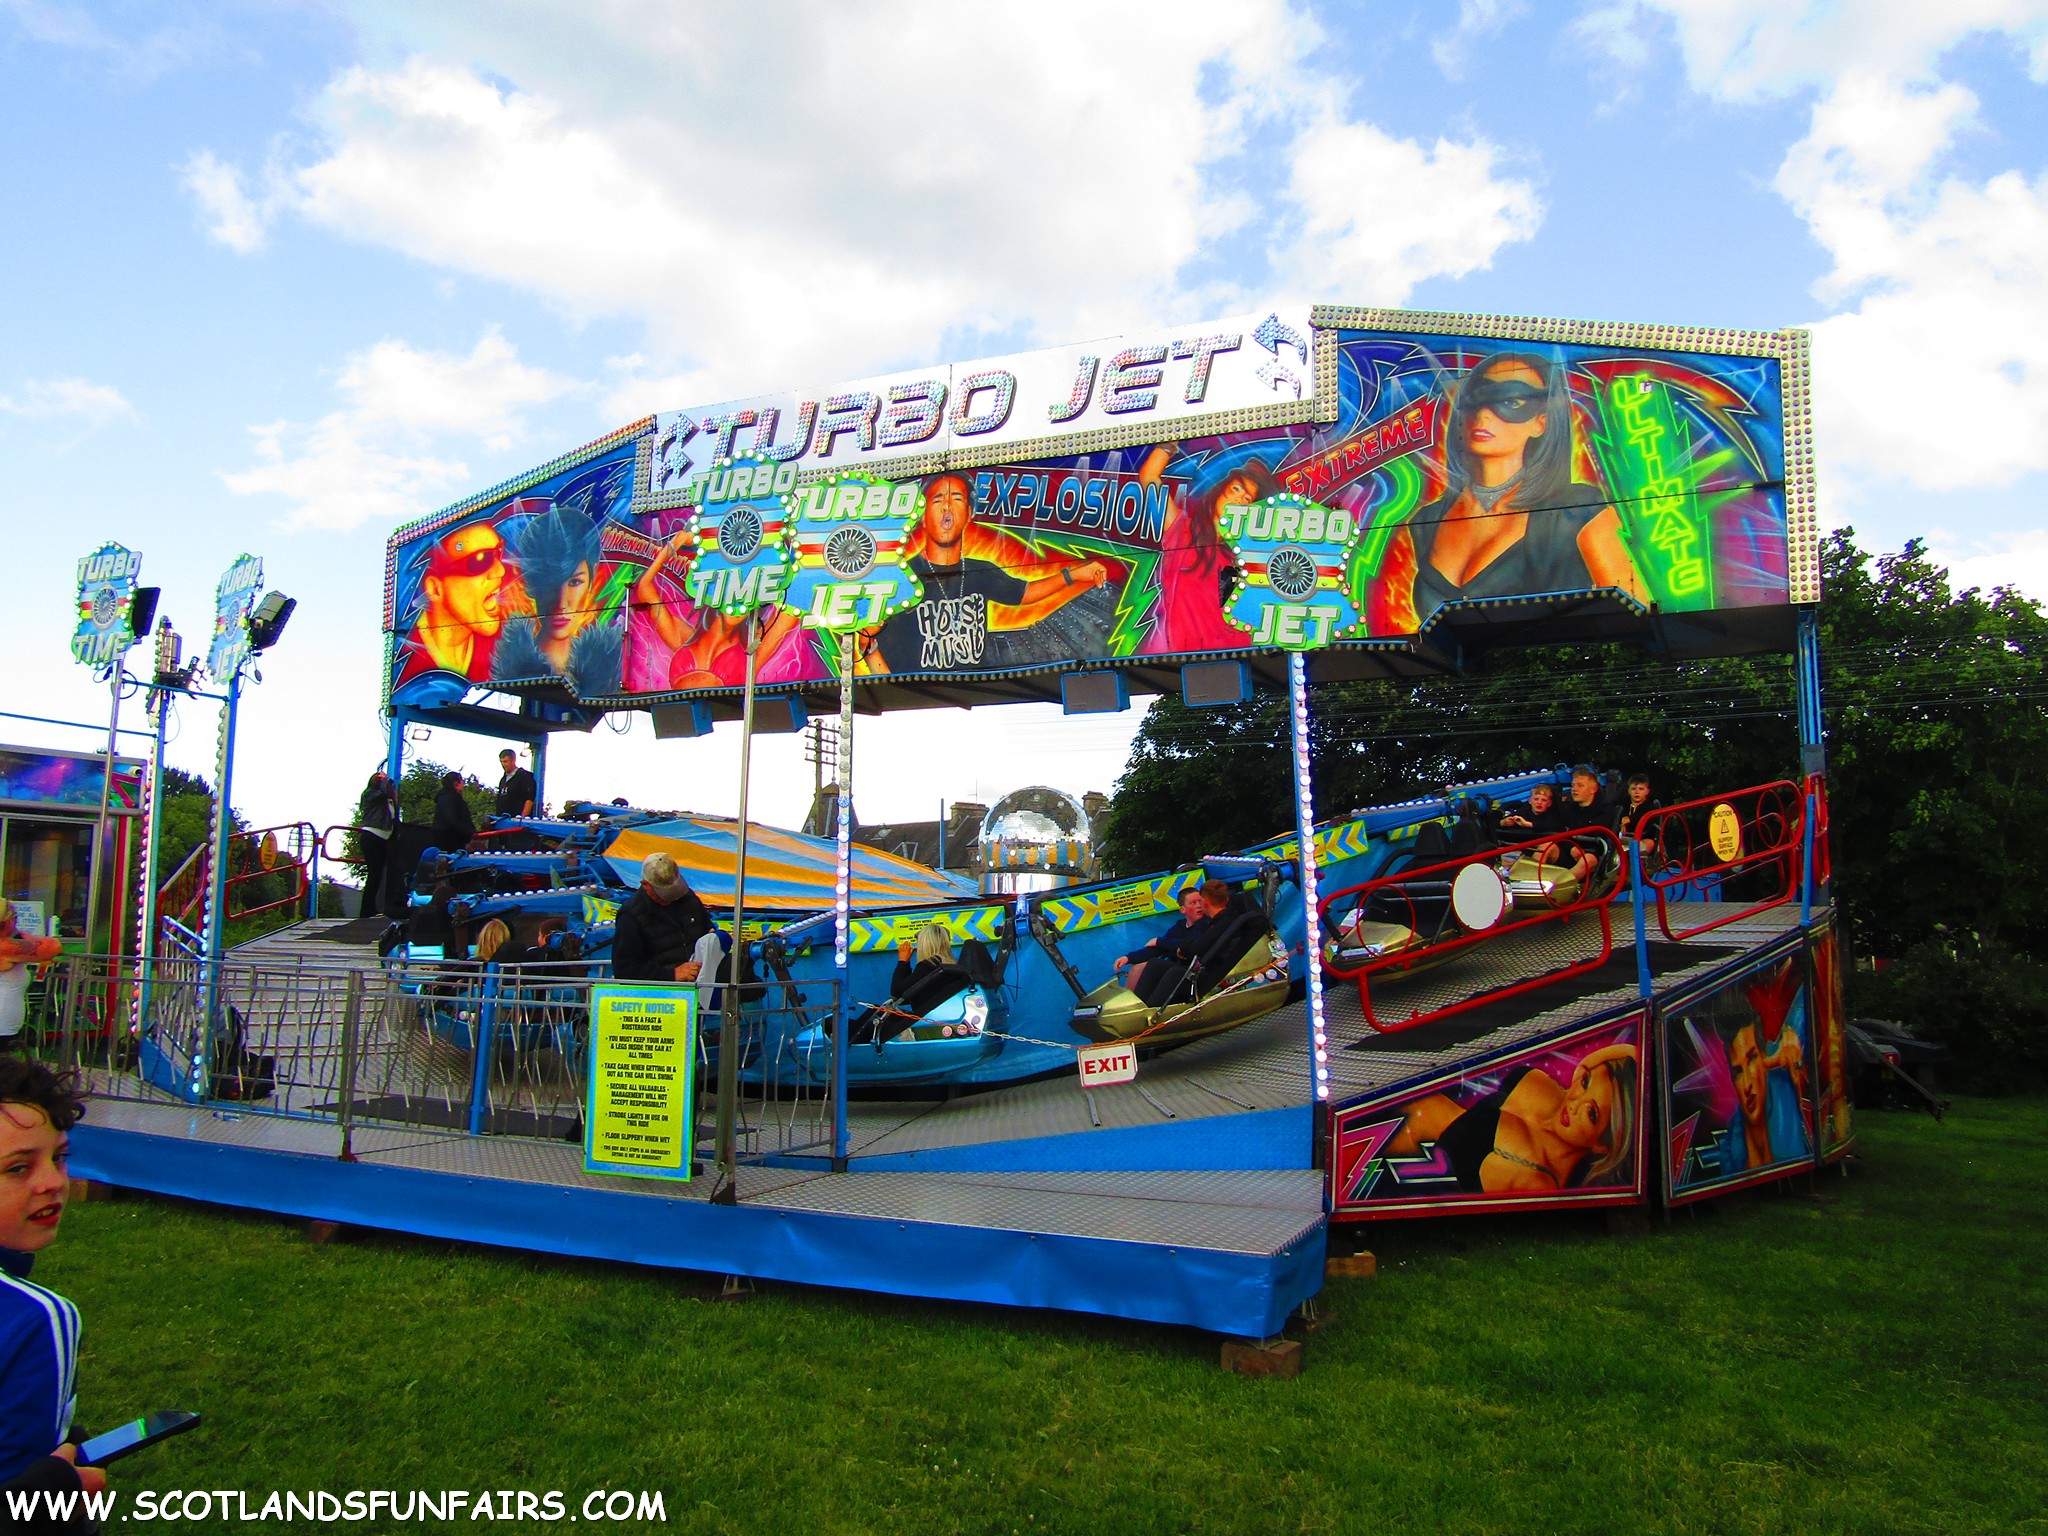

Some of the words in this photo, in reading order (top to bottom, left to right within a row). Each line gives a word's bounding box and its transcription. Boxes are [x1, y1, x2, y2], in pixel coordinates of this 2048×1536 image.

[702, 368, 1017, 468] TURBO
[1048, 333, 1243, 425] JET
[1285, 407, 1427, 498] EXTREME
[691, 461, 799, 505] TURBO
[790, 484, 920, 520] TURBO
[1612, 372, 1705, 596] ULTIMATE
[975, 471, 1170, 544] EXPLOSION
[1225, 504, 1353, 543] TURBO
[78, 550, 142, 584] TURBO
[220, 555, 263, 598] TURBO
[691, 563, 788, 609] TIME
[801, 582, 896, 628] JET
[916, 593, 985, 638] HOUSE
[1252, 603, 1340, 645] JET
[74, 630, 132, 664] TIME
[212, 641, 243, 685] JET
[921, 627, 985, 669] MUSIC
[611, 1002, 642, 1012] SAFETY
[645, 1003, 675, 1014] NOTICE
[1084, 1055, 1131, 1075] EXIT
[621, 1133, 643, 1141] SLIPPERY
